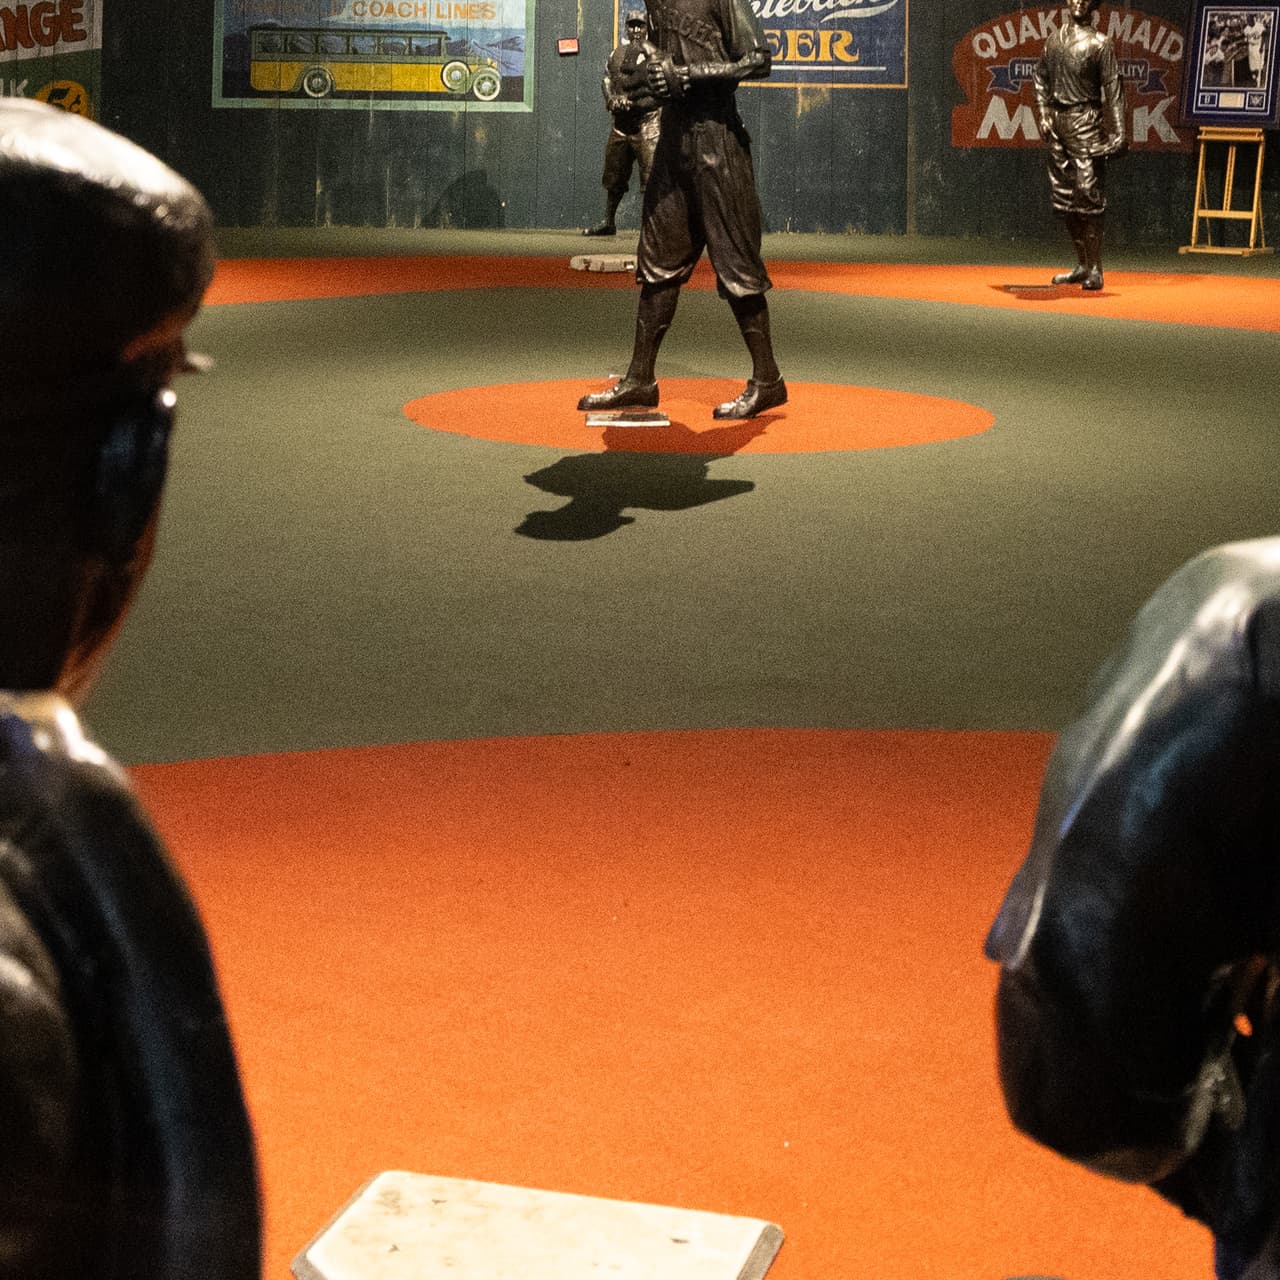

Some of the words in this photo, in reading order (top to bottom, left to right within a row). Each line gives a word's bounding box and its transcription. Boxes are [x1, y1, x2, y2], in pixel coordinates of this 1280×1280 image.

[352, 0, 427, 19] COACH
[435, 2, 496, 20] LINES
[764, 29, 860, 62] EER
[972, 8, 1101, 59] QUAK
[1106, 10, 1185, 62] MAID
[1014, 63, 1038, 76] FIR
